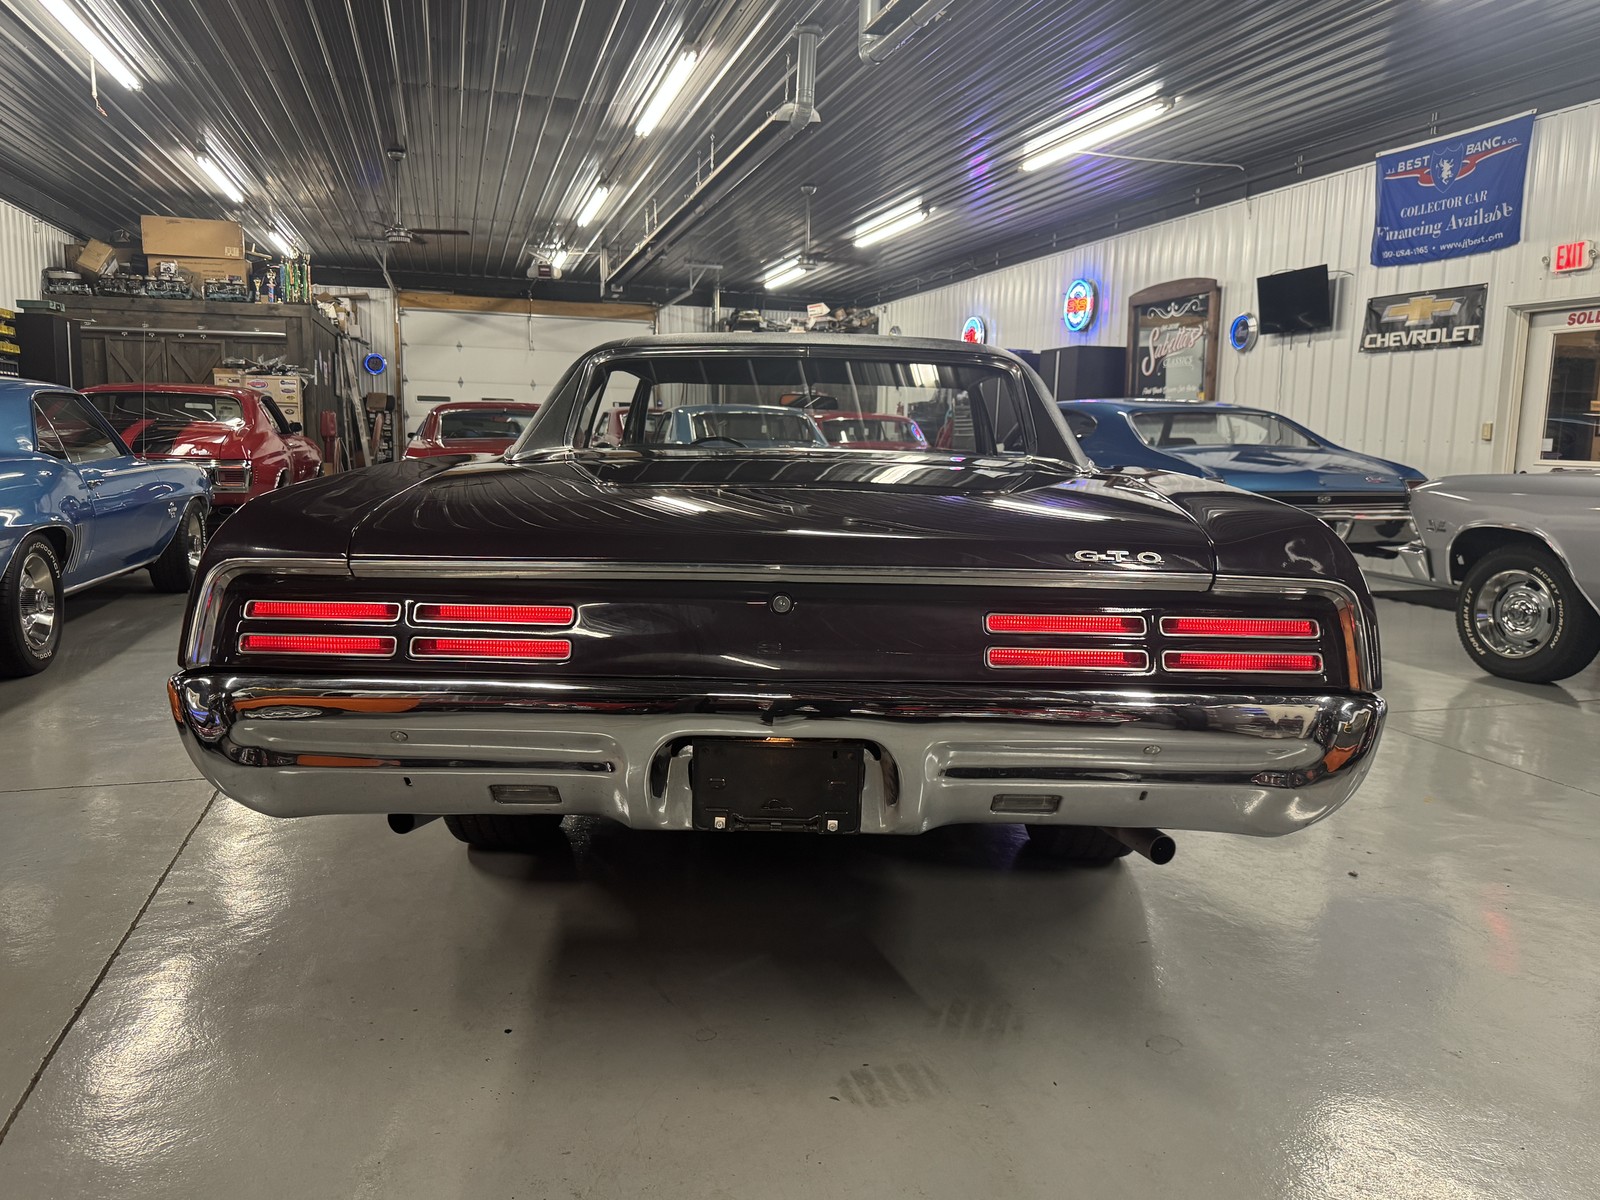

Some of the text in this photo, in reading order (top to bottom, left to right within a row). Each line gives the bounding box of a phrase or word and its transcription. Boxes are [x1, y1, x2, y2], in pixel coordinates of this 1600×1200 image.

[1397, 154, 1431, 173] BEST
[1465, 135, 1502, 156] BANC
[1400, 190, 1488, 219] COLLECTOR CAR
[1377, 220, 1443, 241] Financing
[1556, 242, 1585, 271] EXIT
[1363, 324, 1480, 350] CHEVROLET
[1533, 566, 1565, 649] MICKEY THOMPSON
[1462, 605, 1486, 656] SPORTSMAN
